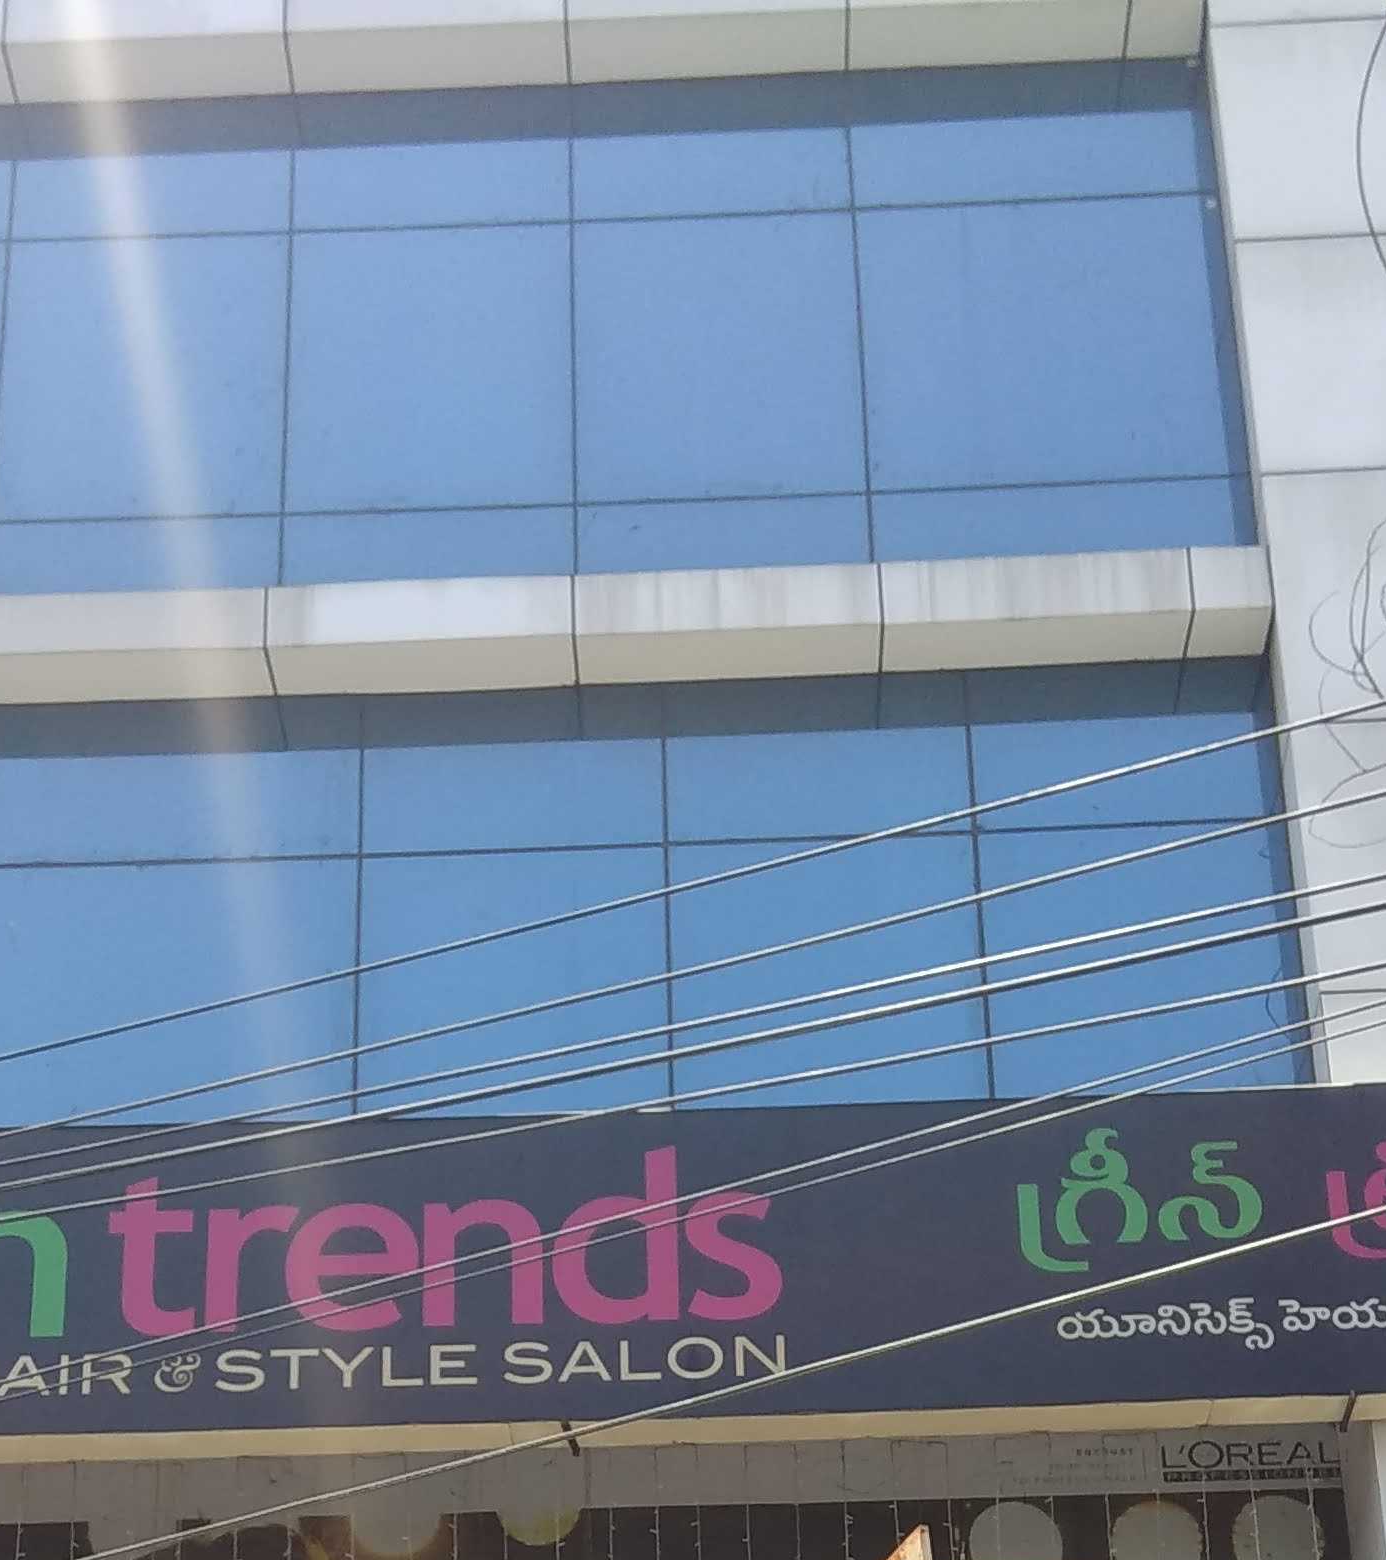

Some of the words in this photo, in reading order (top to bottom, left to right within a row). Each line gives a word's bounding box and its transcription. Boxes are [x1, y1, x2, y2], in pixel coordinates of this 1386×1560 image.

[107, 1144, 784, 1335] trends
[1017, 1127, 1263, 1272] గ్రీన్
[213, 1342, 481, 1393] STYLE
[500, 1334, 789, 1386] SALON
